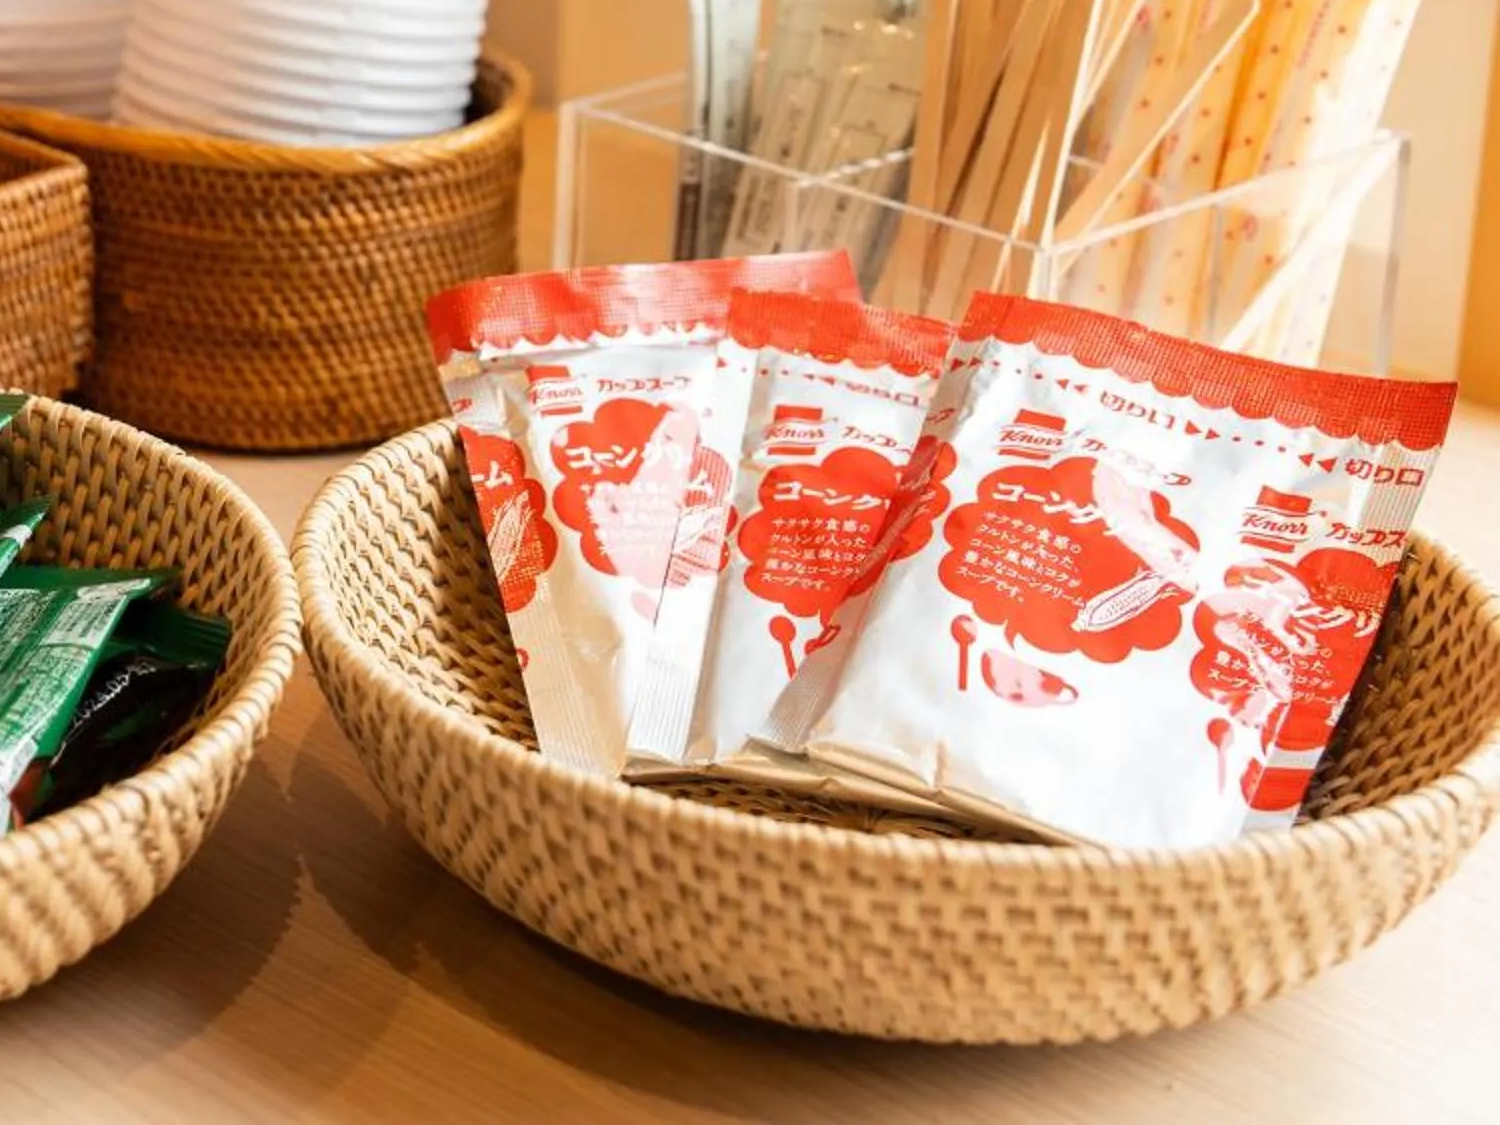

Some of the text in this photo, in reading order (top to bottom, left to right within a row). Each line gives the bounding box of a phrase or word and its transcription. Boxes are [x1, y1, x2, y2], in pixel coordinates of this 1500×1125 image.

[1000, 429, 1064, 447] Knorr
[1345, 457, 1425, 487] 切り口
[1242, 512, 1309, 537] Knorr
